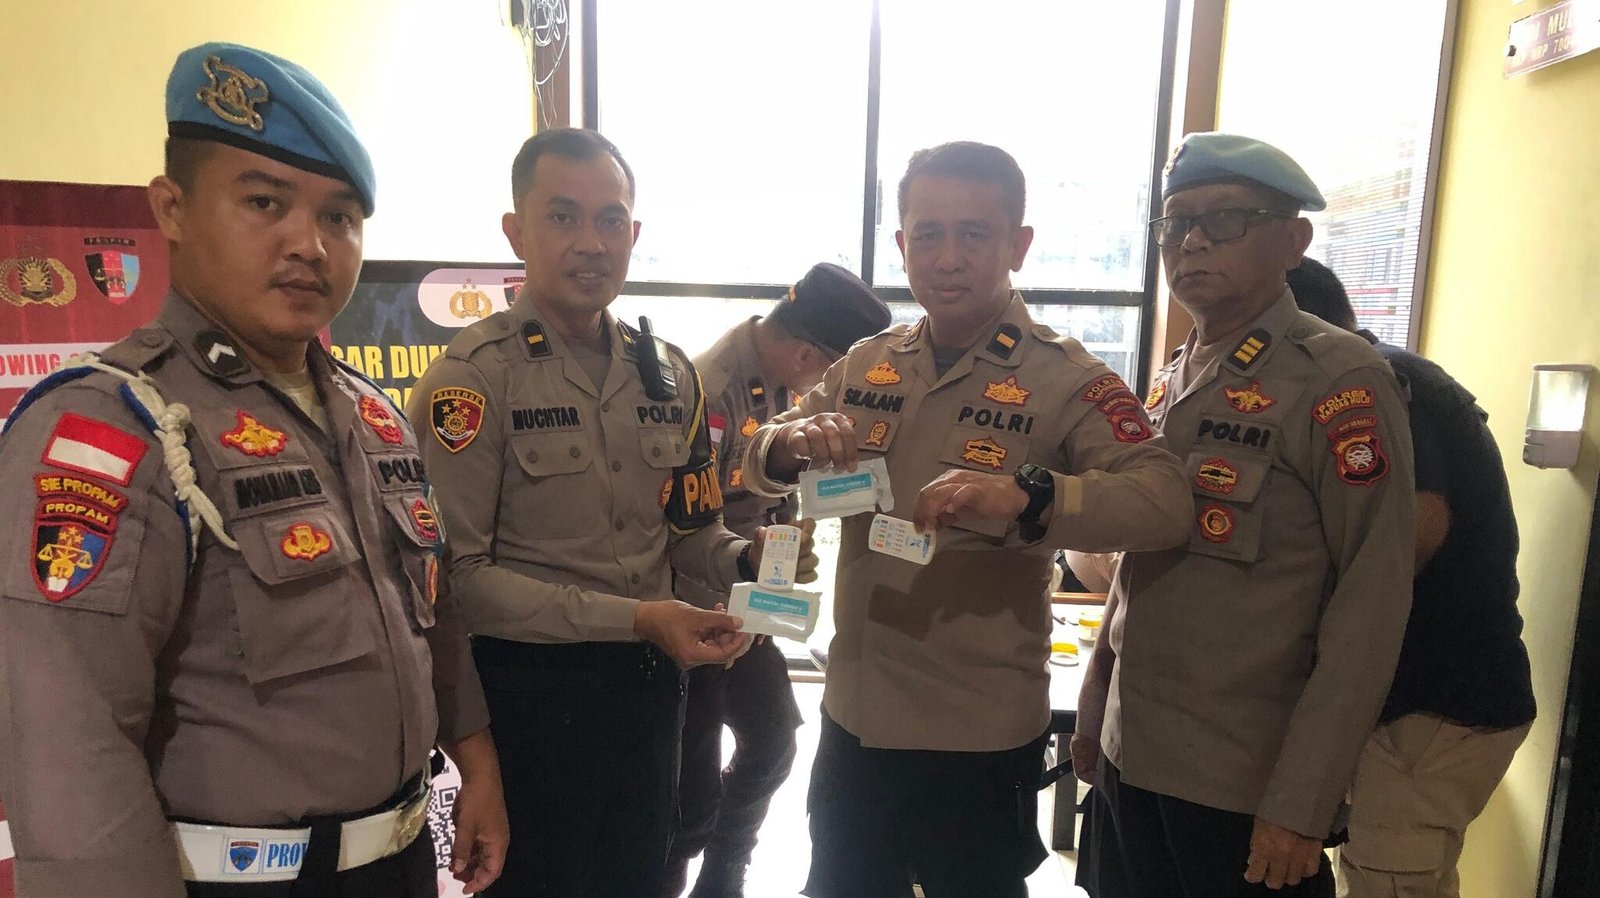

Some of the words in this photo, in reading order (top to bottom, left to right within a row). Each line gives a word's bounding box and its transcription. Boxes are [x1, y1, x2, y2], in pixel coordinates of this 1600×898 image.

[512, 407, 581, 430] MUCHTAR
[636, 405, 683, 425] POLRI
[958, 406, 1034, 435] POLRI
[1198, 419, 1271, 449] POLRI
[40, 477, 62, 492] SIE
[63, 478, 120, 508] PROPAM
[45, 503, 110, 524] PROPAM
